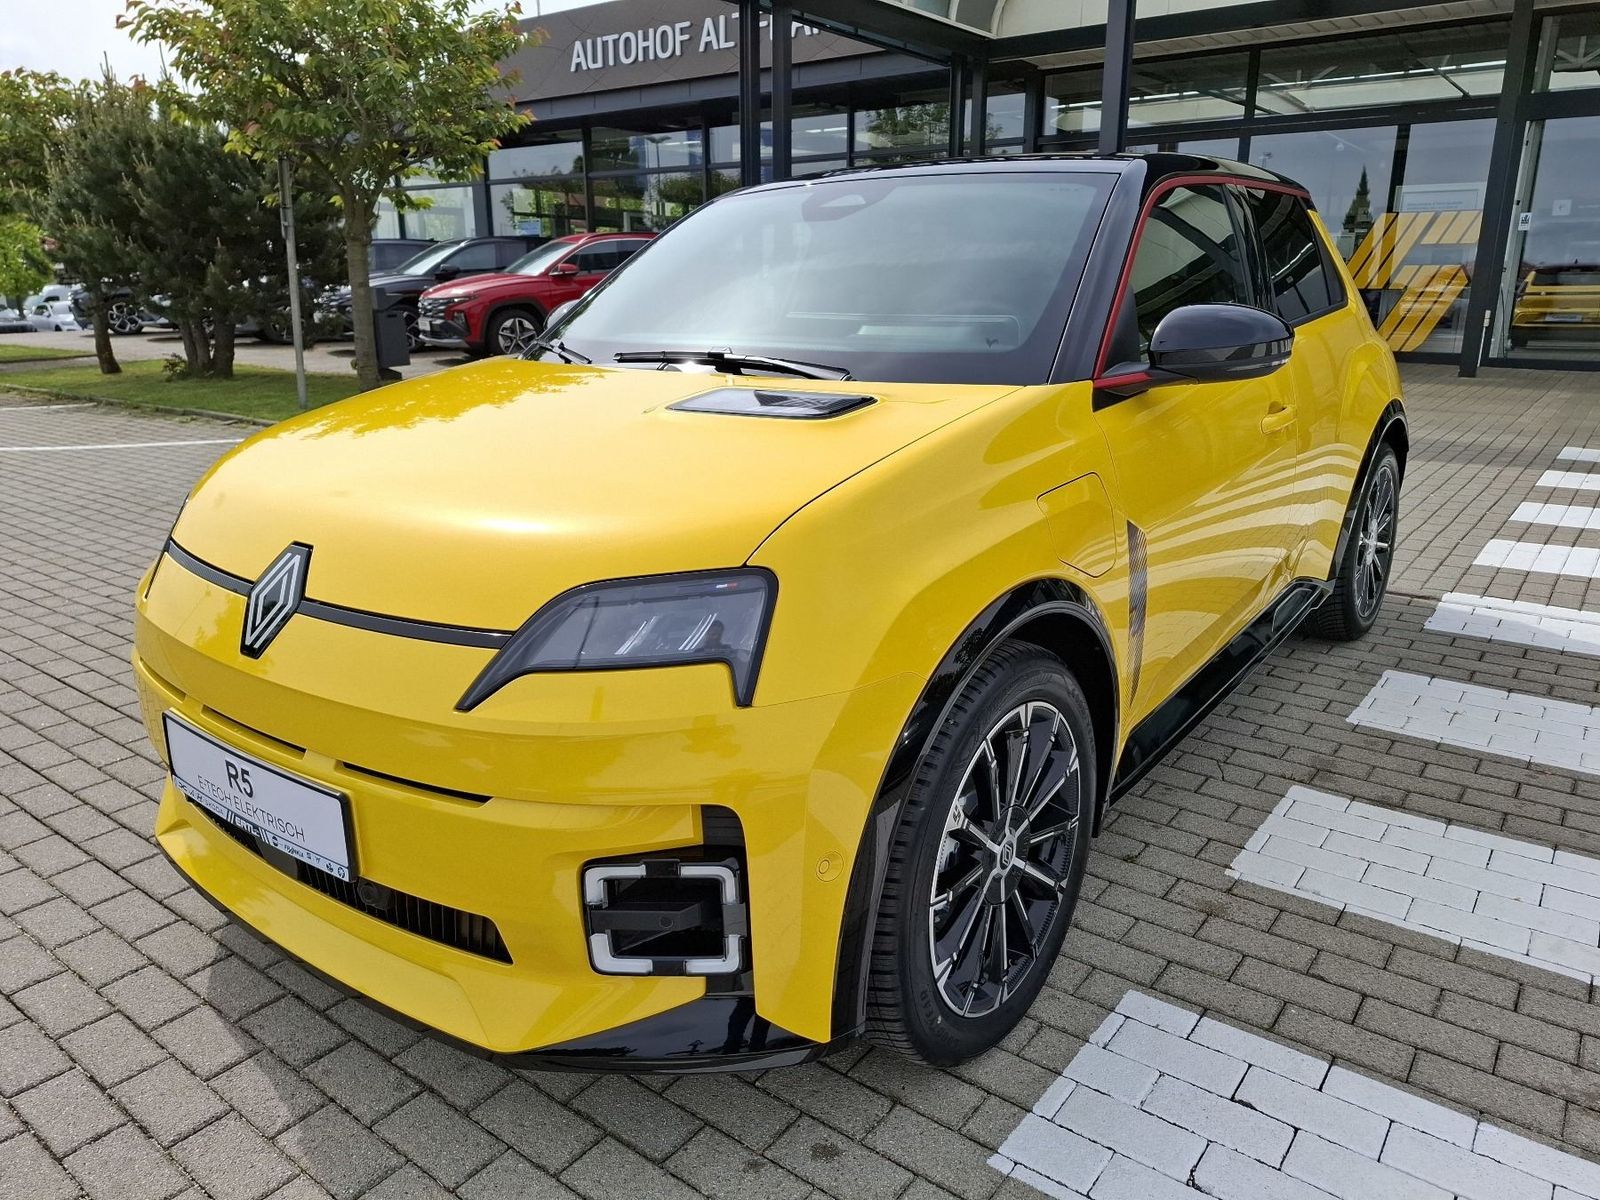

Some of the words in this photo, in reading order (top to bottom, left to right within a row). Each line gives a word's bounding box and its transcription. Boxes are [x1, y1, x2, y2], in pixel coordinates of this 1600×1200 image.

[570, 21, 692, 72] AUTOHOF
[224, 759, 254, 798] R5
[197, 774, 232, 807] E-TECH
[233, 795, 305, 842] ELEKTRISCH
